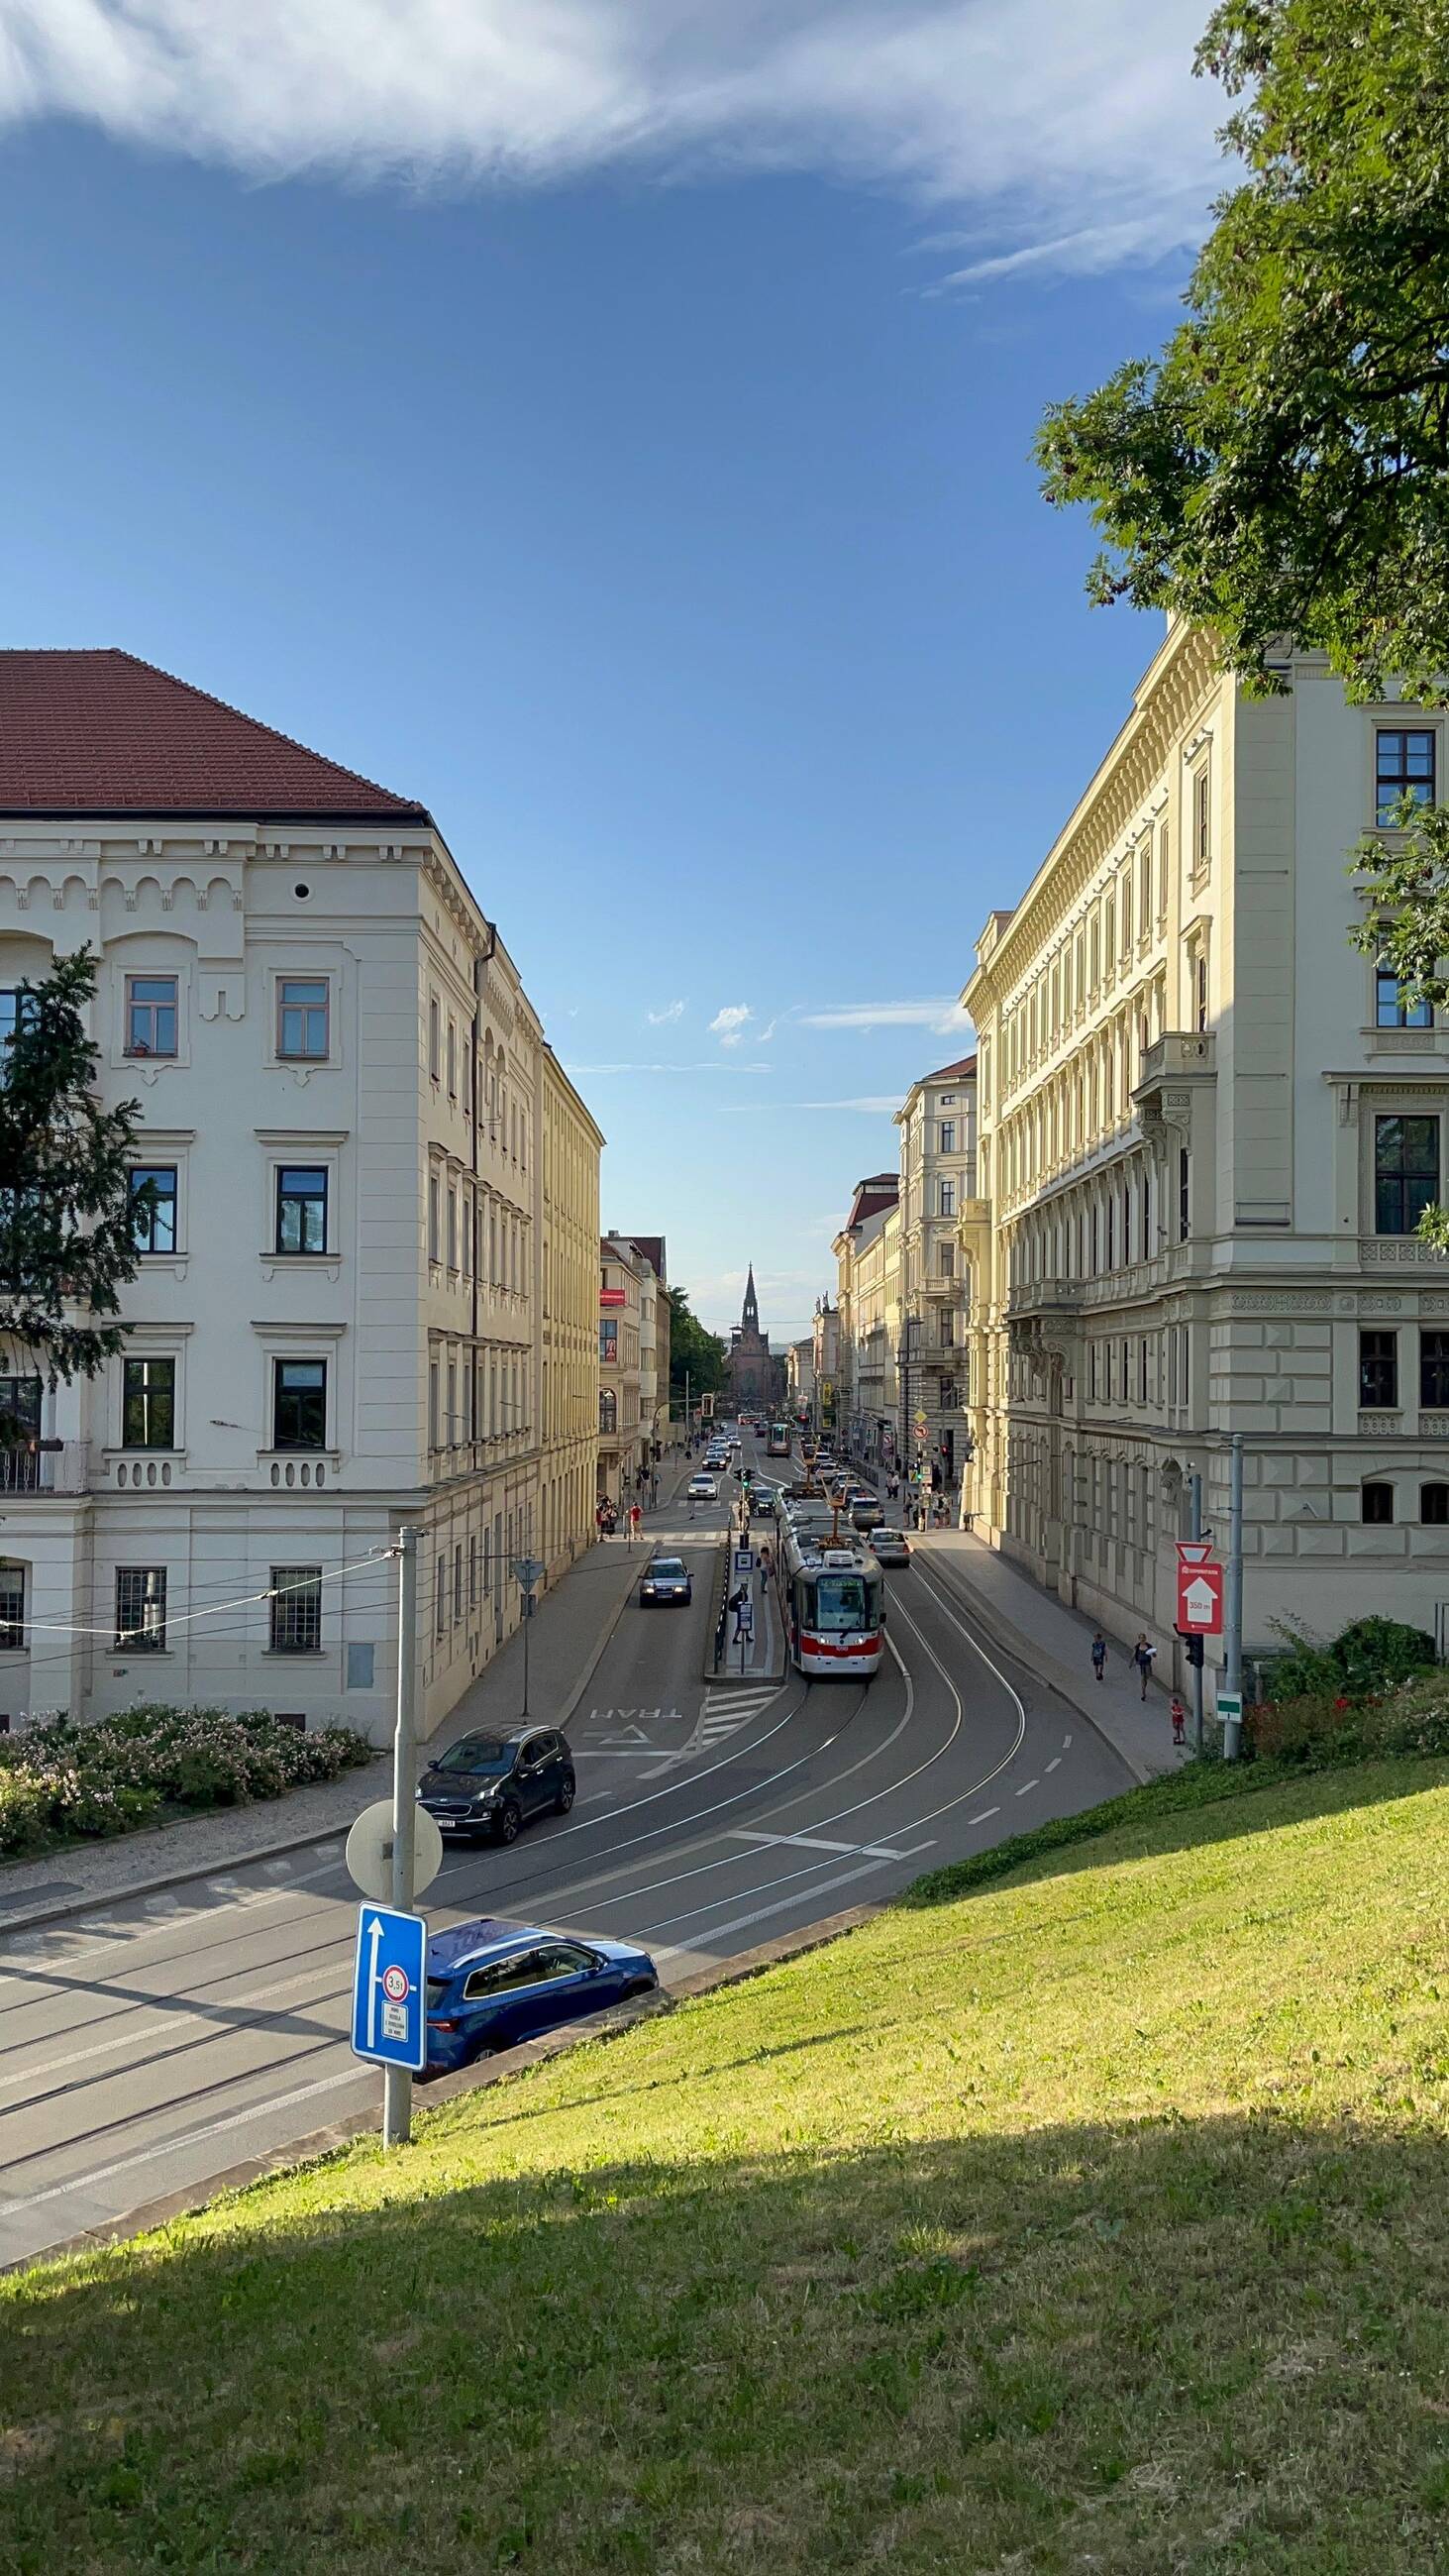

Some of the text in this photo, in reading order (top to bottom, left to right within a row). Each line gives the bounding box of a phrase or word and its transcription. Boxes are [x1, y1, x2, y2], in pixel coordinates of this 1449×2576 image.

[1190, 1601, 1202, 1610] 350
[589, 1708, 682, 1719] TRAM
[388, 1976, 403, 1990] 3,5t
